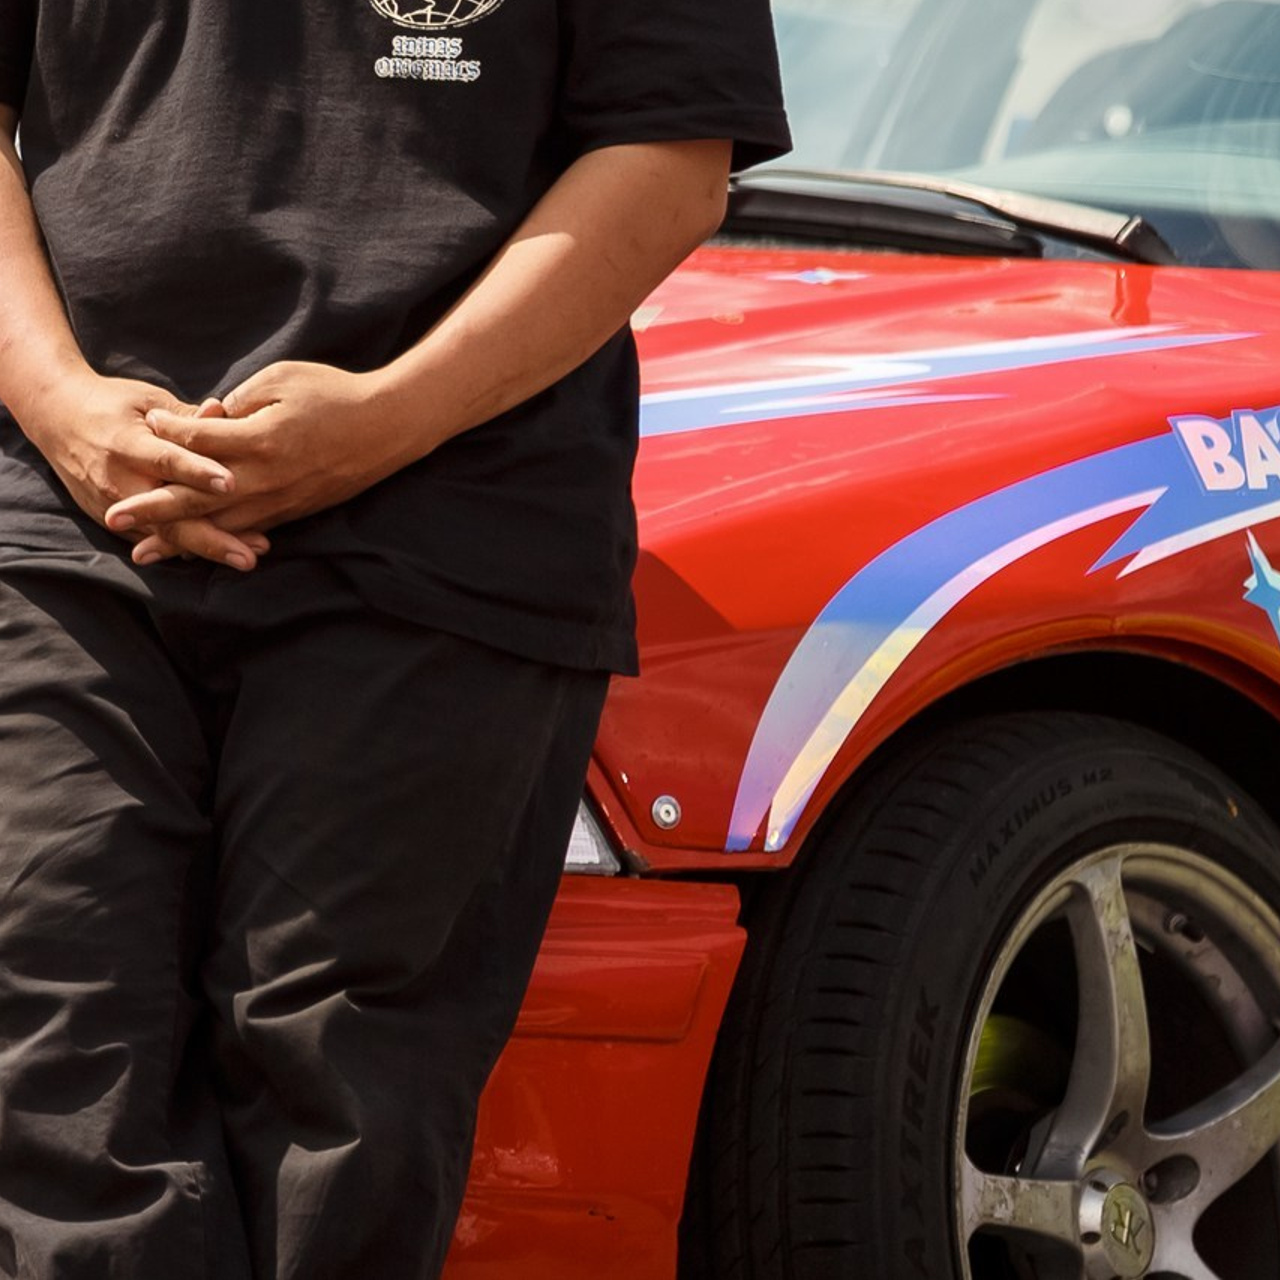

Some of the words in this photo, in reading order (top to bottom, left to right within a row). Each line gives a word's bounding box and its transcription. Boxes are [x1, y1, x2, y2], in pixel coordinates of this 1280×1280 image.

[392, 35, 463, 58] ADIDAS
[374, 56, 481, 83] ORIGINALS
[968, 777, 1073, 888] MAXIMUS
[1082, 767, 1114, 787] M2
